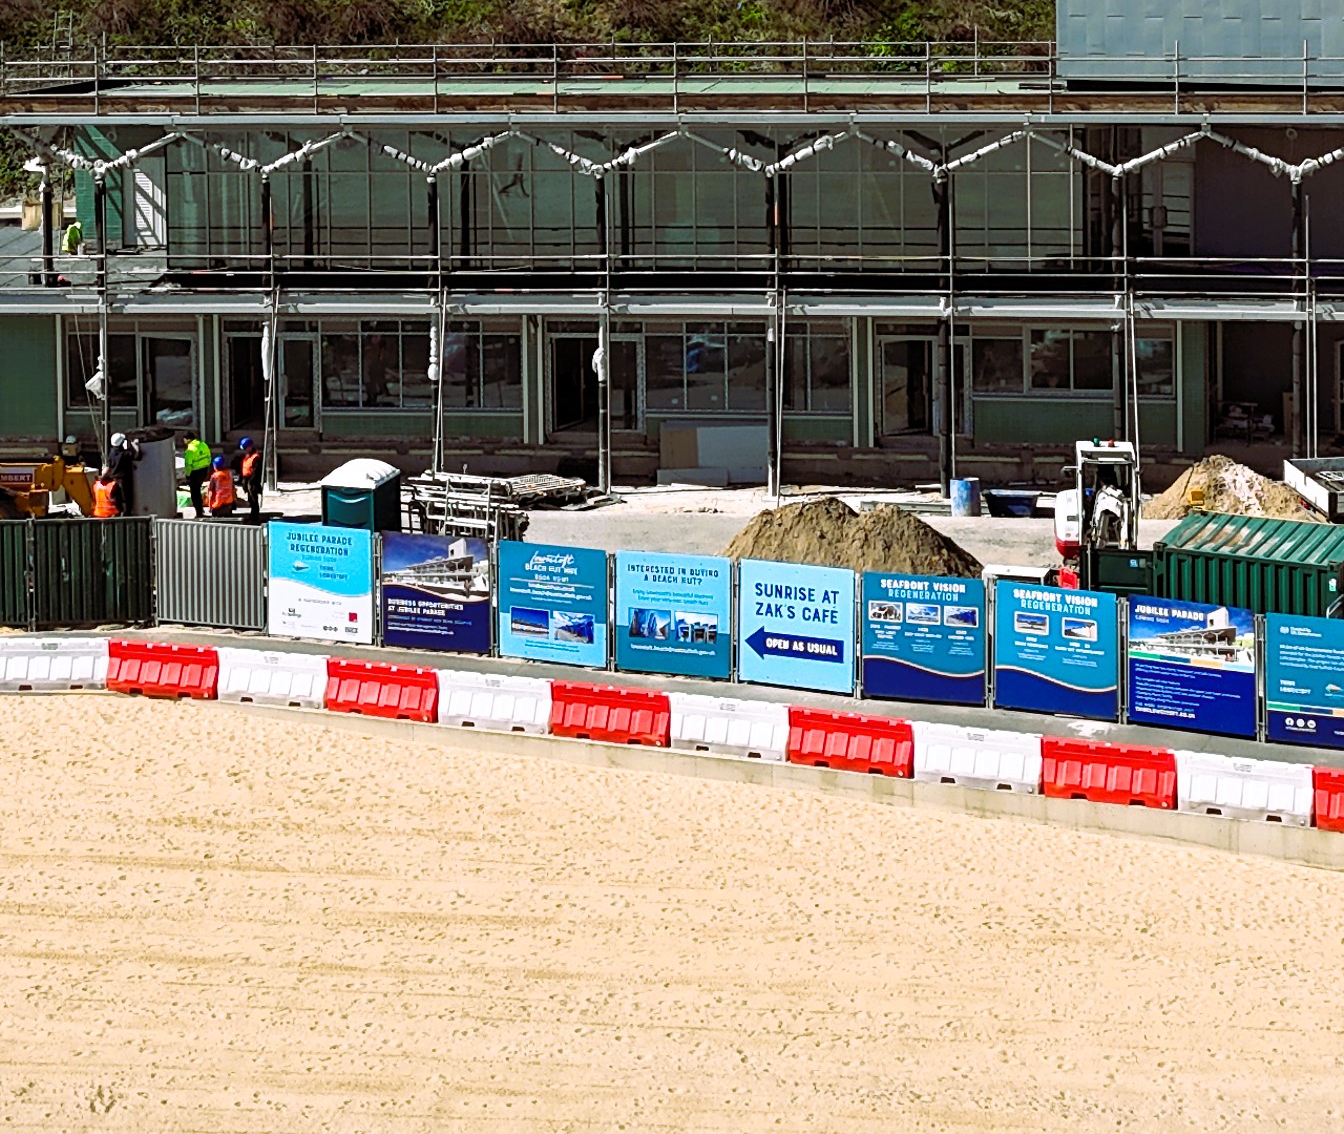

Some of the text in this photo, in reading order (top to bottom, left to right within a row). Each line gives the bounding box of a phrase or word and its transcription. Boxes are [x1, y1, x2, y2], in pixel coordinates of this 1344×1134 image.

[286, 532, 353, 546] JUBILEE PARADE
[290, 543, 349, 556] REGENERATION
[627, 564, 675, 575] INTERESTED
[677, 567, 687, 575] IN
[652, 574, 678, 584] BEACH
[681, 577, 703, 586] HUT?
[880, 579, 966, 593] SEAFRONT VISION
[754, 582, 840, 604] SUNRISE AT
[888, 588, 959, 602] REGENERATION
[1013, 588, 1098, 608] SEAFRONT VISION
[755, 601, 839, 624] ZAK'S CAFÉ
[1020, 599, 1091, 616] REGENERATION
[1134, 604, 1205, 622] JUBILEE PARADE
[765, 637, 838, 656] OPEN AS USUAL
